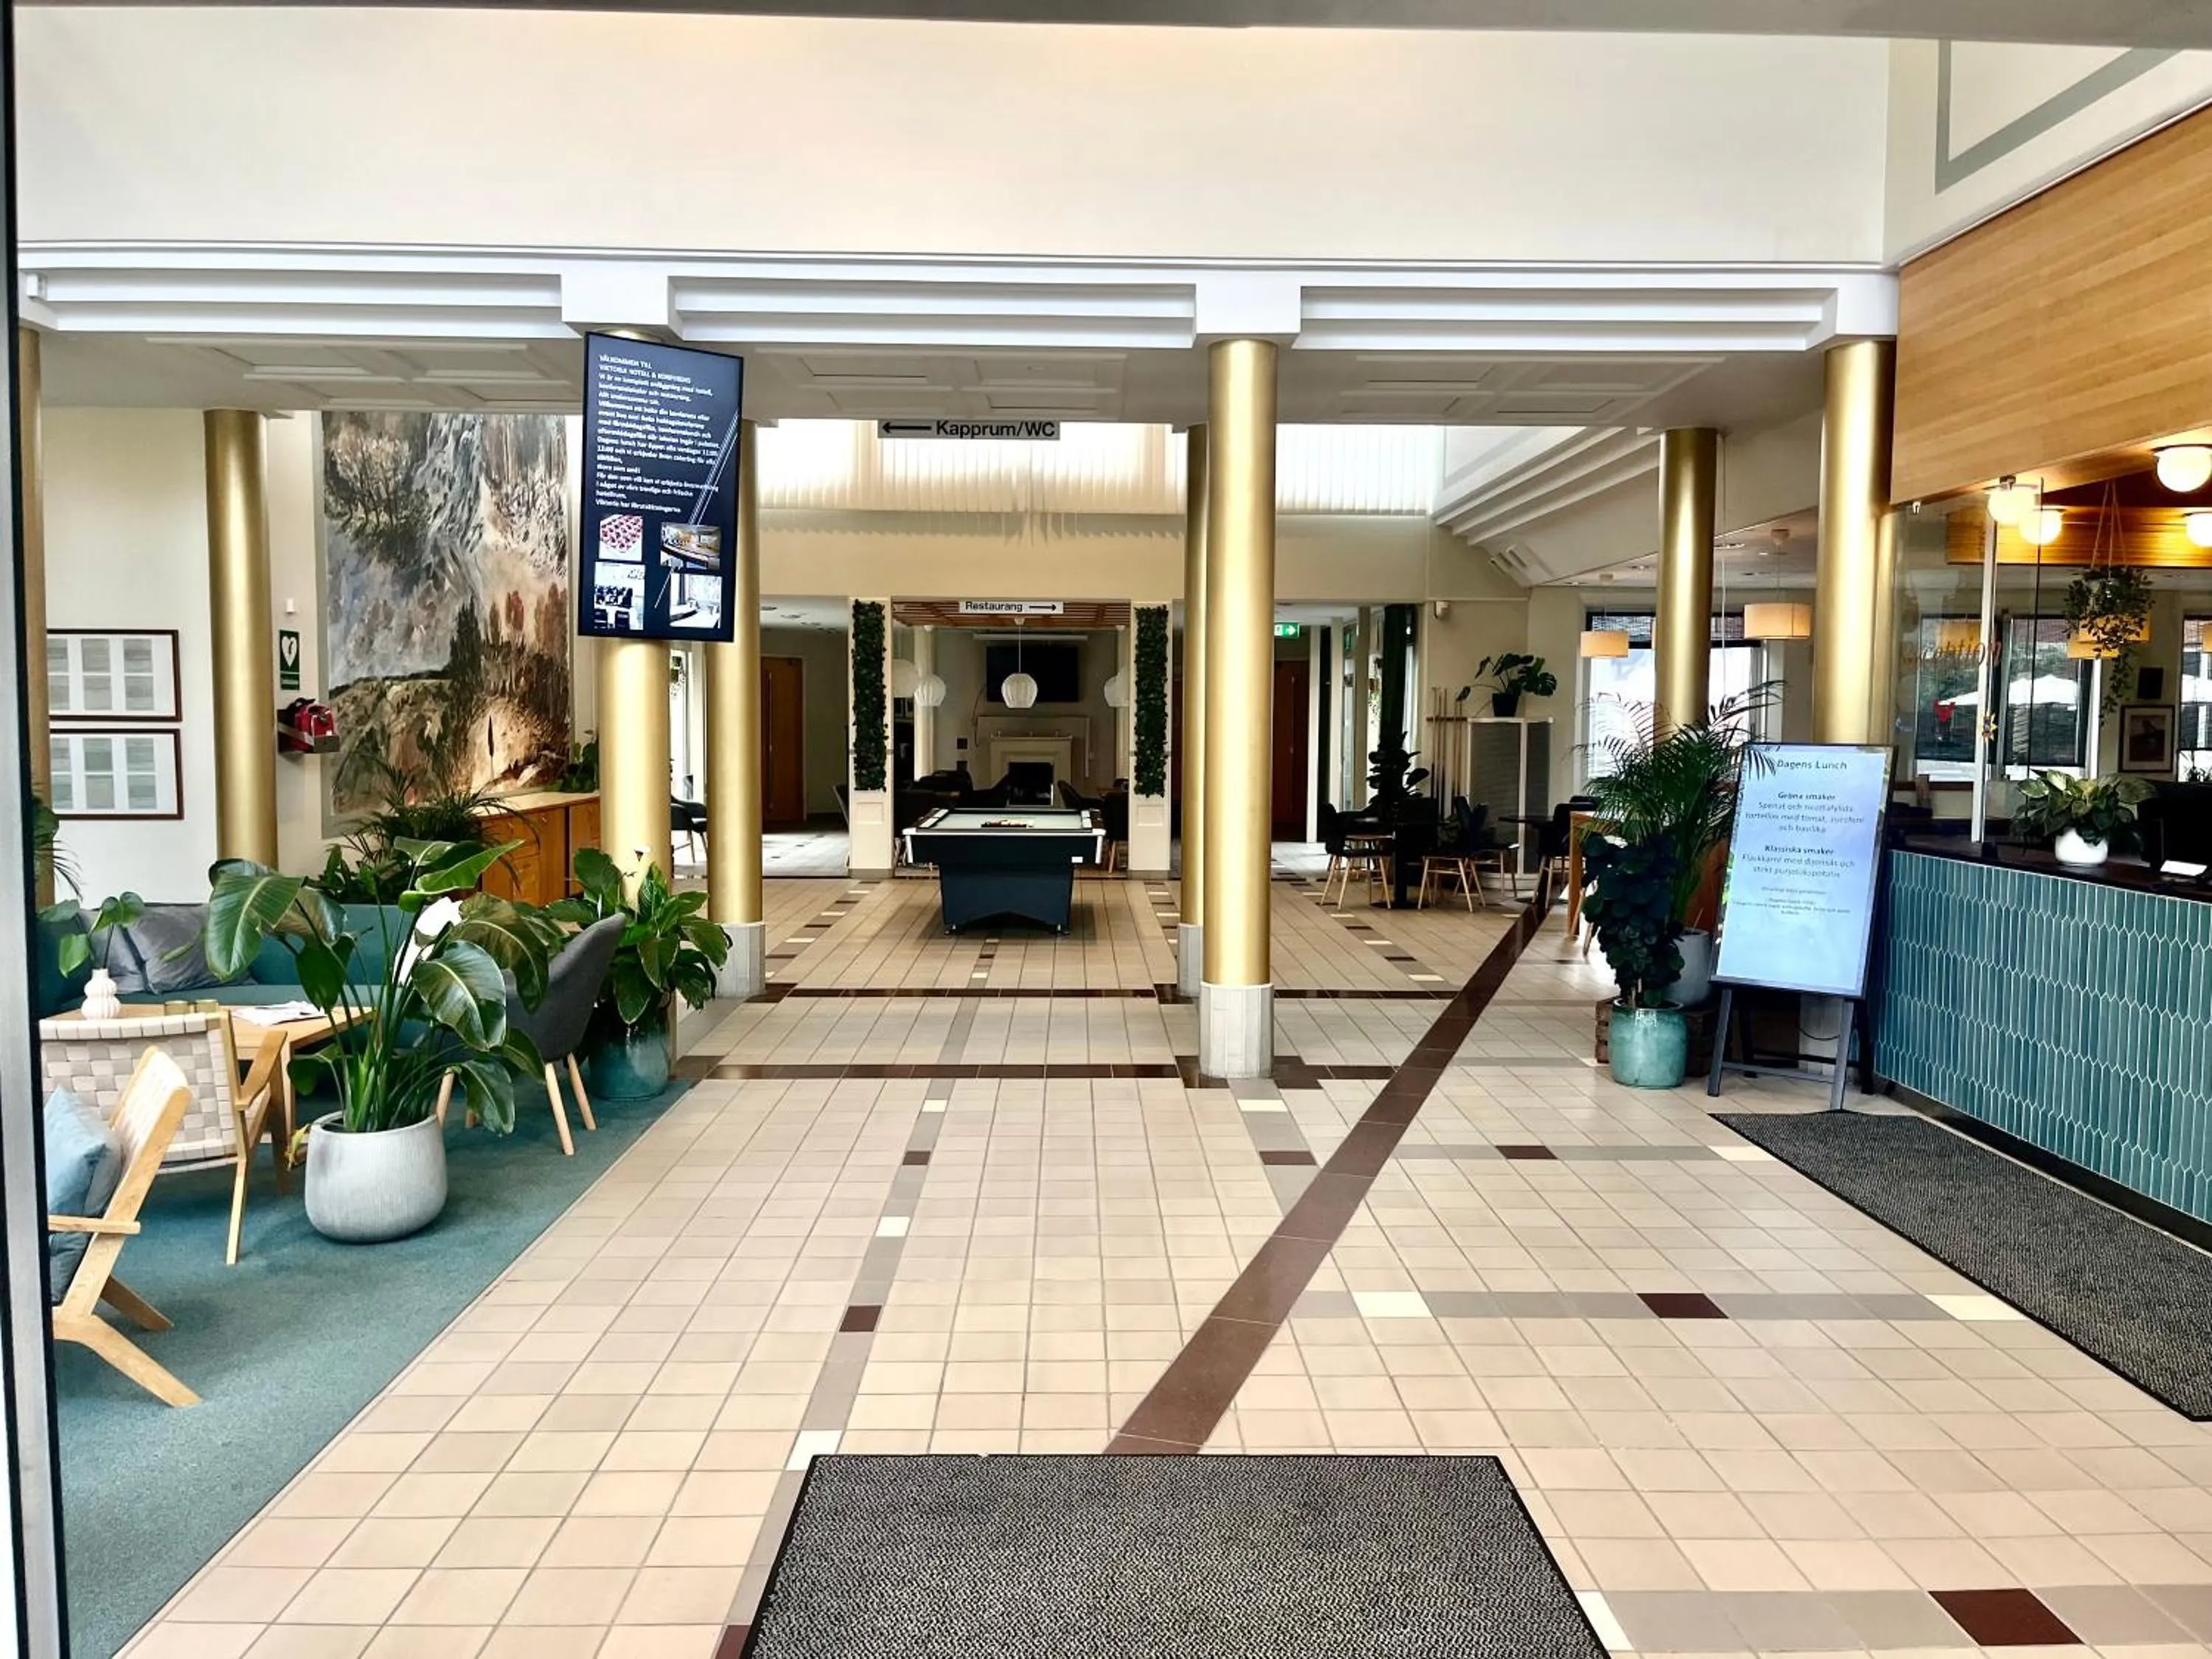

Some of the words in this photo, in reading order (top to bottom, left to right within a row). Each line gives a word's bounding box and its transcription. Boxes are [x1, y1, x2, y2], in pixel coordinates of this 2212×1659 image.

[936, 420, 1055, 439] Kapprum/WC
[965, 601, 1023, 611] Restaurang
[1777, 760, 1812, 769] Dagens
[1816, 761, 1847, 769] Lunch
[1804, 846, 1834, 855] smaker
